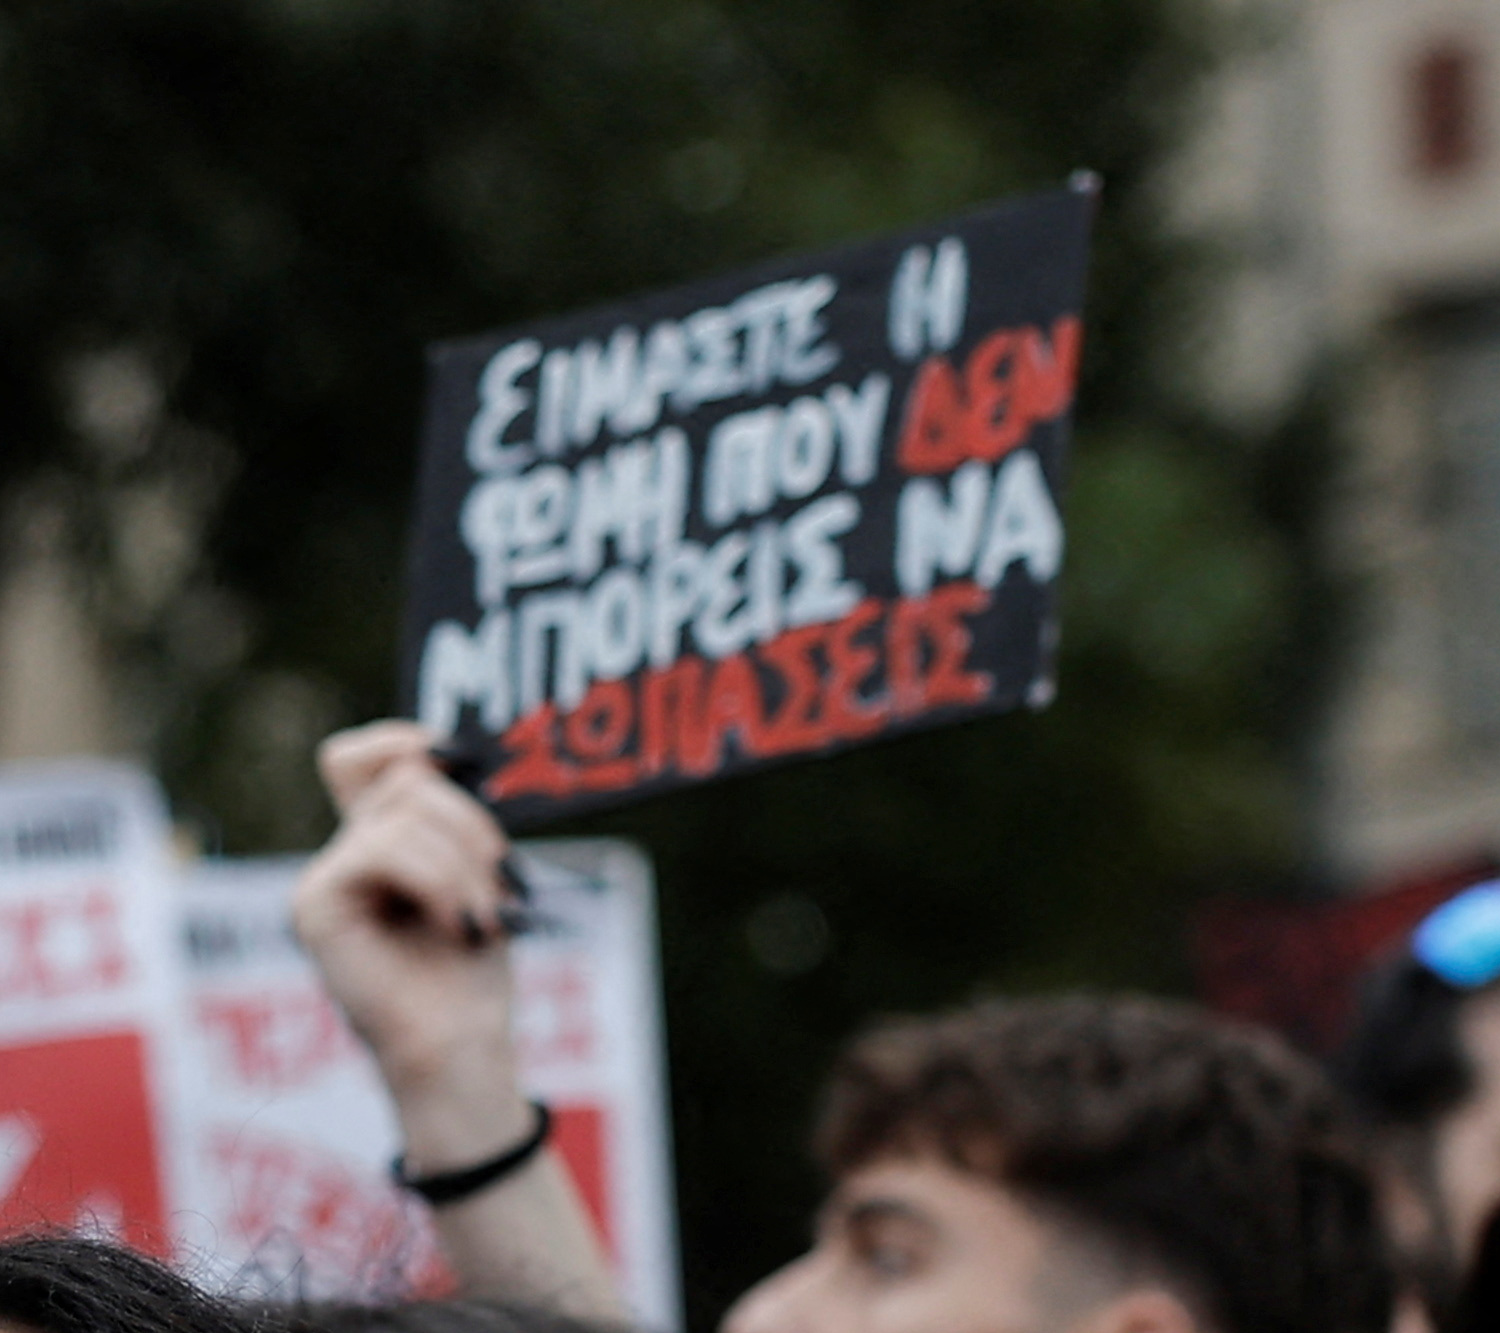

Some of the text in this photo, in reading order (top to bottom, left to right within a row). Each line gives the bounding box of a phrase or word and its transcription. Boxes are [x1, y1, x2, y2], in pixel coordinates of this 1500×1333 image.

[464, 236, 970, 476] ΕΙΜΑΣΤΕ Η
[703, 372, 890, 526] ΠΟΥ
[896, 313, 1084, 474] ΔΕΝ
[418, 448, 1065, 742] ΜΠΟΡΕΙΣ ΝΑ
